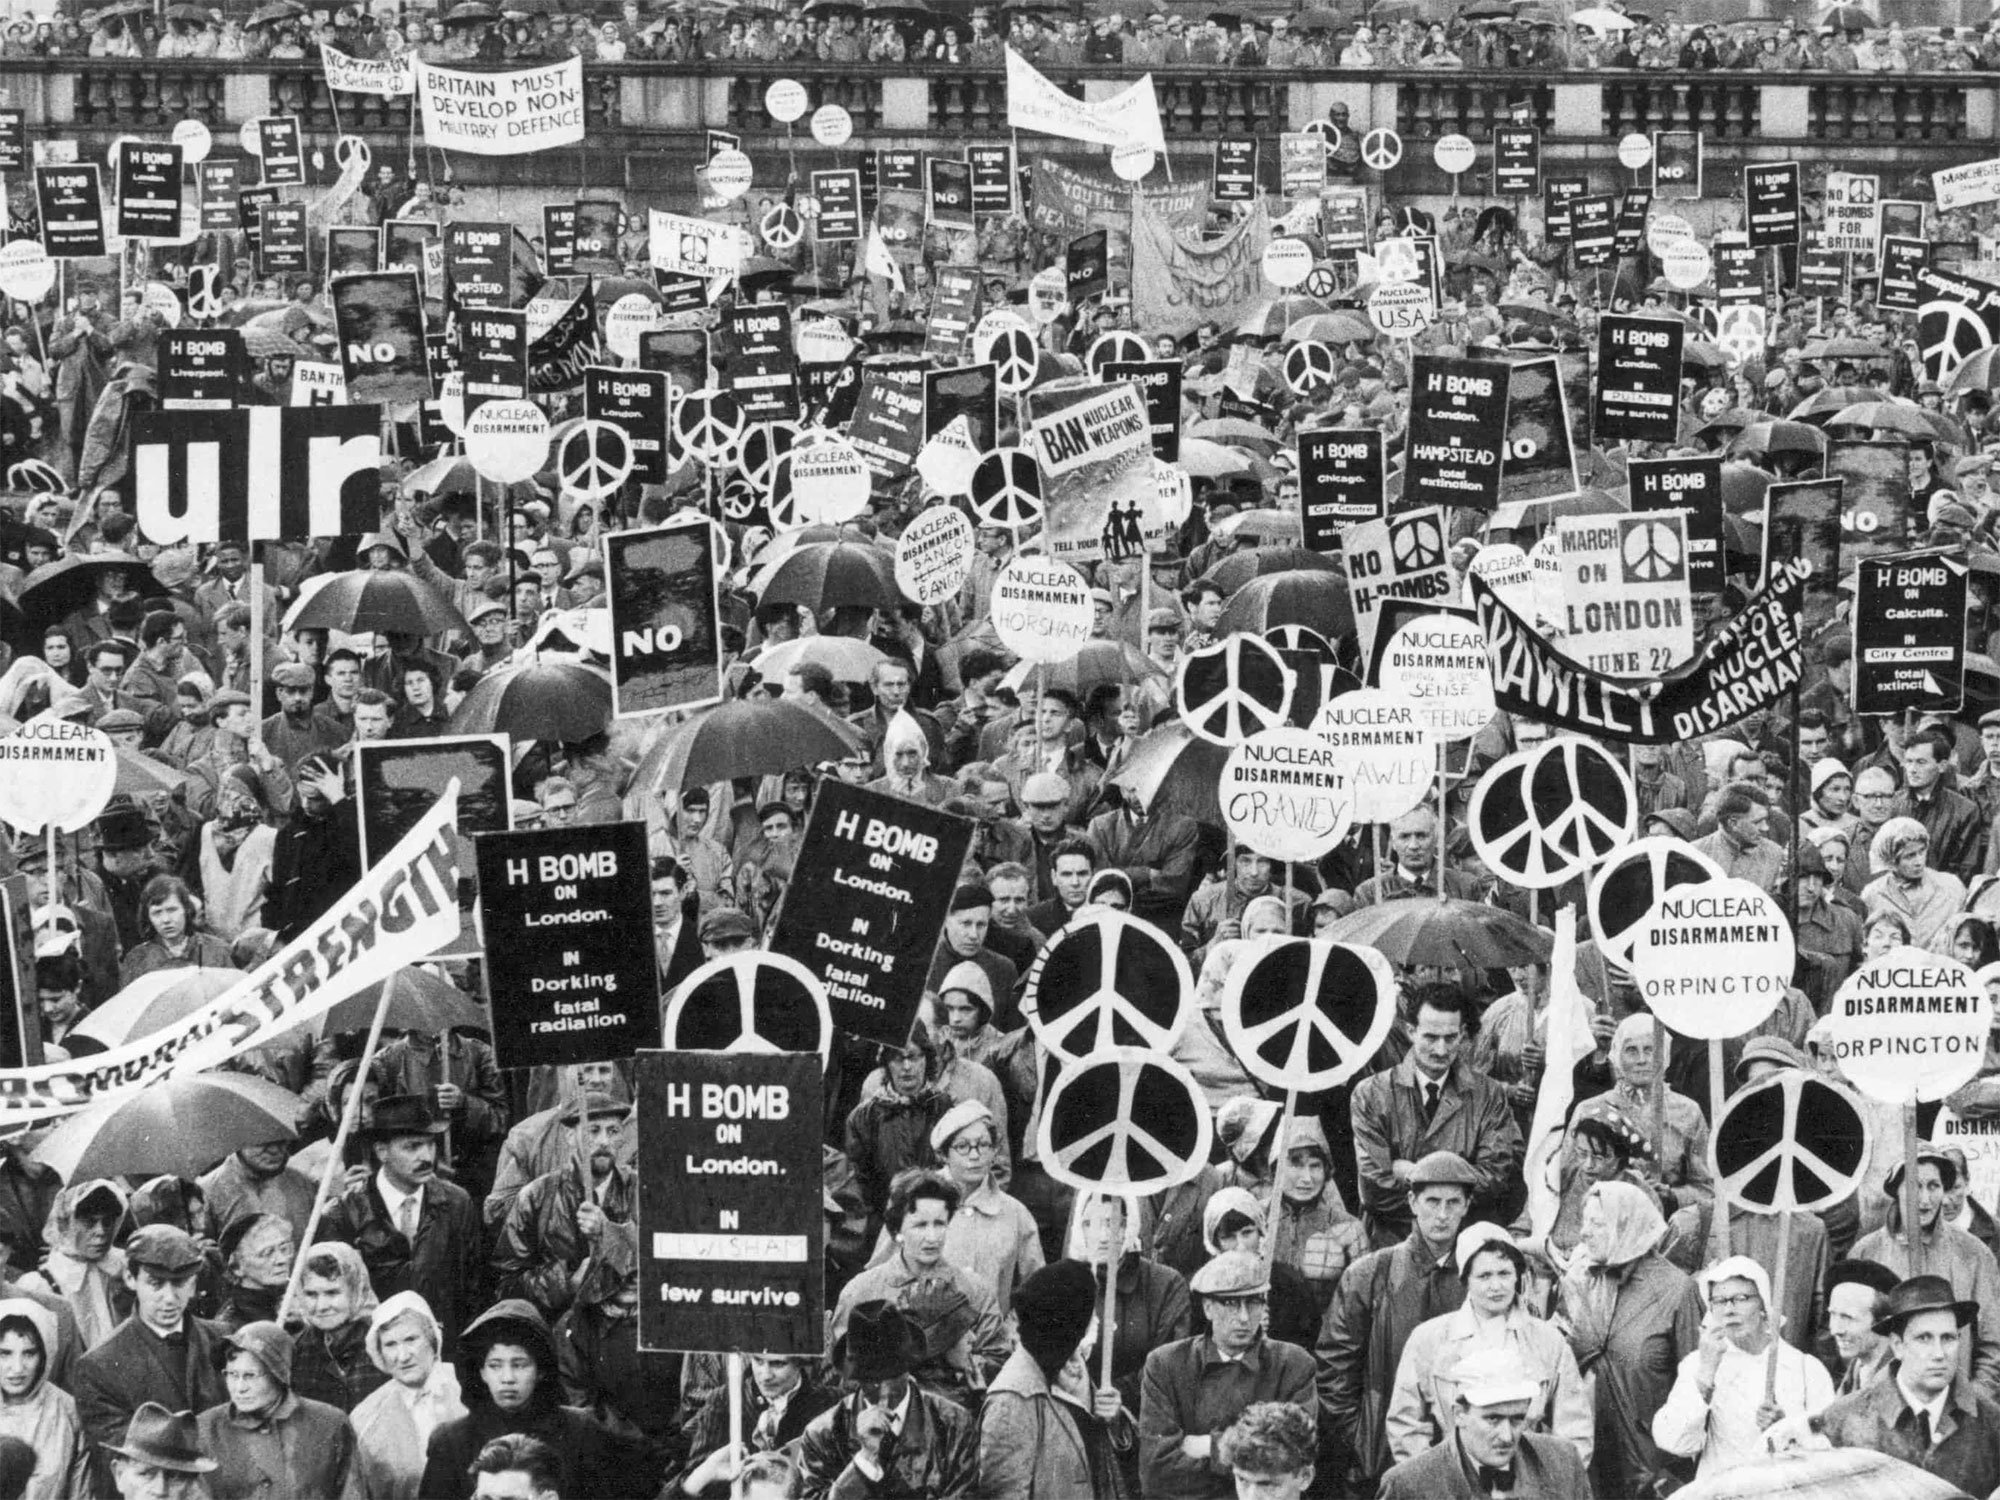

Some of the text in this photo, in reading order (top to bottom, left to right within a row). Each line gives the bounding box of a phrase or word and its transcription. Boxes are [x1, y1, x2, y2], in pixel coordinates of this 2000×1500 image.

[428, 70, 566, 96] BRITAIN MUST
[433, 88, 579, 118] DEVELOP NON-
[439, 107, 580, 138] MILITARY DEFENCE
[131, 152, 172, 164] H BOMB
[46, 175, 88, 188] H BOMB
[1659, 166, 1684, 178] NO
[1755, 173, 1789, 186] H BOMB
[935, 193, 958, 203] NO
[1061, 183, 1115, 209] YOUTH
[1828, 188, 1842, 201] NO
[659, 216, 728, 241] HESTON &
[880, 226, 907, 240] NO
[1840, 222, 1861, 234] FOR
[455, 232, 500, 245] H BOMB
[577, 239, 602, 251] NO
[1828, 237, 1873, 249] BRITAIN
[657, 255, 735, 278] ISLEWORTH
[1070, 267, 1093, 281] NO
[1379, 287, 1422, 296] NUCLEAR
[1918, 265, 1983, 307] Campaign
[1371, 296, 1429, 306] DISARMAMENT
[472, 322, 516, 339] H BOMB
[734, 317, 780, 333] H BOMB
[1612, 329, 1669, 347] H BOMB
[171, 342, 225, 355] H BOMB
[349, 341, 396, 363] NO
[301, 369, 344, 386] BAN TH
[1428, 374, 1492, 396] H BOMB
[310, 388, 334, 406] H
[598, 382, 650, 396] H BOMB
[872, 386, 925, 417] H BOMB
[479, 407, 538, 421] NUCLEAR
[1606, 408, 1669, 420] few survive
[472, 422, 545, 434] DISARMAMENT
[1039, 395, 1136, 465] BAN NUCLEAR
[1088, 417, 1144, 447] WEAPONS
[798, 451, 854, 464] NUCLEAR
[1313, 444, 1367, 459] H BOMB
[1414, 444, 1494, 465] HAMPSTEAD
[134, 403, 383, 547] ulr
[793, 464, 863, 480] DISARMAMENT
[1439, 469, 1466, 479] total
[1644, 473, 1705, 490] H BOMB
[1419, 476, 1483, 492] extinction
[903, 509, 960, 547] NUCLEAR
[900, 522, 964, 564] DISARMAMENT
[1054, 537, 1098, 553] TELL YOUR
[1562, 529, 1618, 552] MARCH
[1349, 550, 1381, 579] NO
[1471, 554, 1525, 575] NUCLEAR
[1578, 564, 1606, 583] ON
[1009, 570, 1077, 587] NUCLEAR
[1878, 568, 1947, 587] H BOMB
[1002, 587, 1085, 604] DISARMAMENT
[1904, 589, 1919, 599] ON
[1567, 598, 1681, 635] LONDON
[998, 613, 1088, 642] HORSHAM
[623, 622, 682, 656] NO
[1402, 632, 1486, 650] NUCLEAR
[1904, 635, 1916, 645] IN
[1587, 647, 1673, 673] JUNE 22
[1870, 647, 1949, 659] City Centre
[1477, 593, 1663, 736] CRAWLEY
[1326, 708, 1412, 725] NUCLEAR
[1245, 745, 1334, 767] NUCLEAR
[1235, 767, 1343, 789] DISARMAMENT
[835, 810, 938, 866] H BOMB
[507, 851, 617, 884] H BOMB
[869, 853, 892, 871] ON
[555, 885, 577, 900] ON
[1662, 898, 1766, 919] NUCLEAR
[219, 822, 459, 1046] STRENGTH
[852, 918, 869, 935] IN
[1651, 926, 1778, 946] DISARMAMENT
[562, 951, 580, 966] IN
[816, 933, 894, 974] Dorking
[531, 971, 617, 993] Dorking
[823, 964, 868, 990] fatal
[1645, 975, 1790, 998] ORPINGTON
[1857, 968, 1966, 989] NUCLEAR
[554, 998, 599, 1014] fatal
[1846, 997, 1979, 1016] DISARMAMENT
[531, 1014, 626, 1033] radiation
[1837, 1036, 1978, 1058] ORPINGTON
[668, 1083, 789, 1119] H BOMB
[717, 1124, 741, 1143] ON
[720, 1210, 738, 1229] IN
[661, 1283, 800, 1306] few survive
